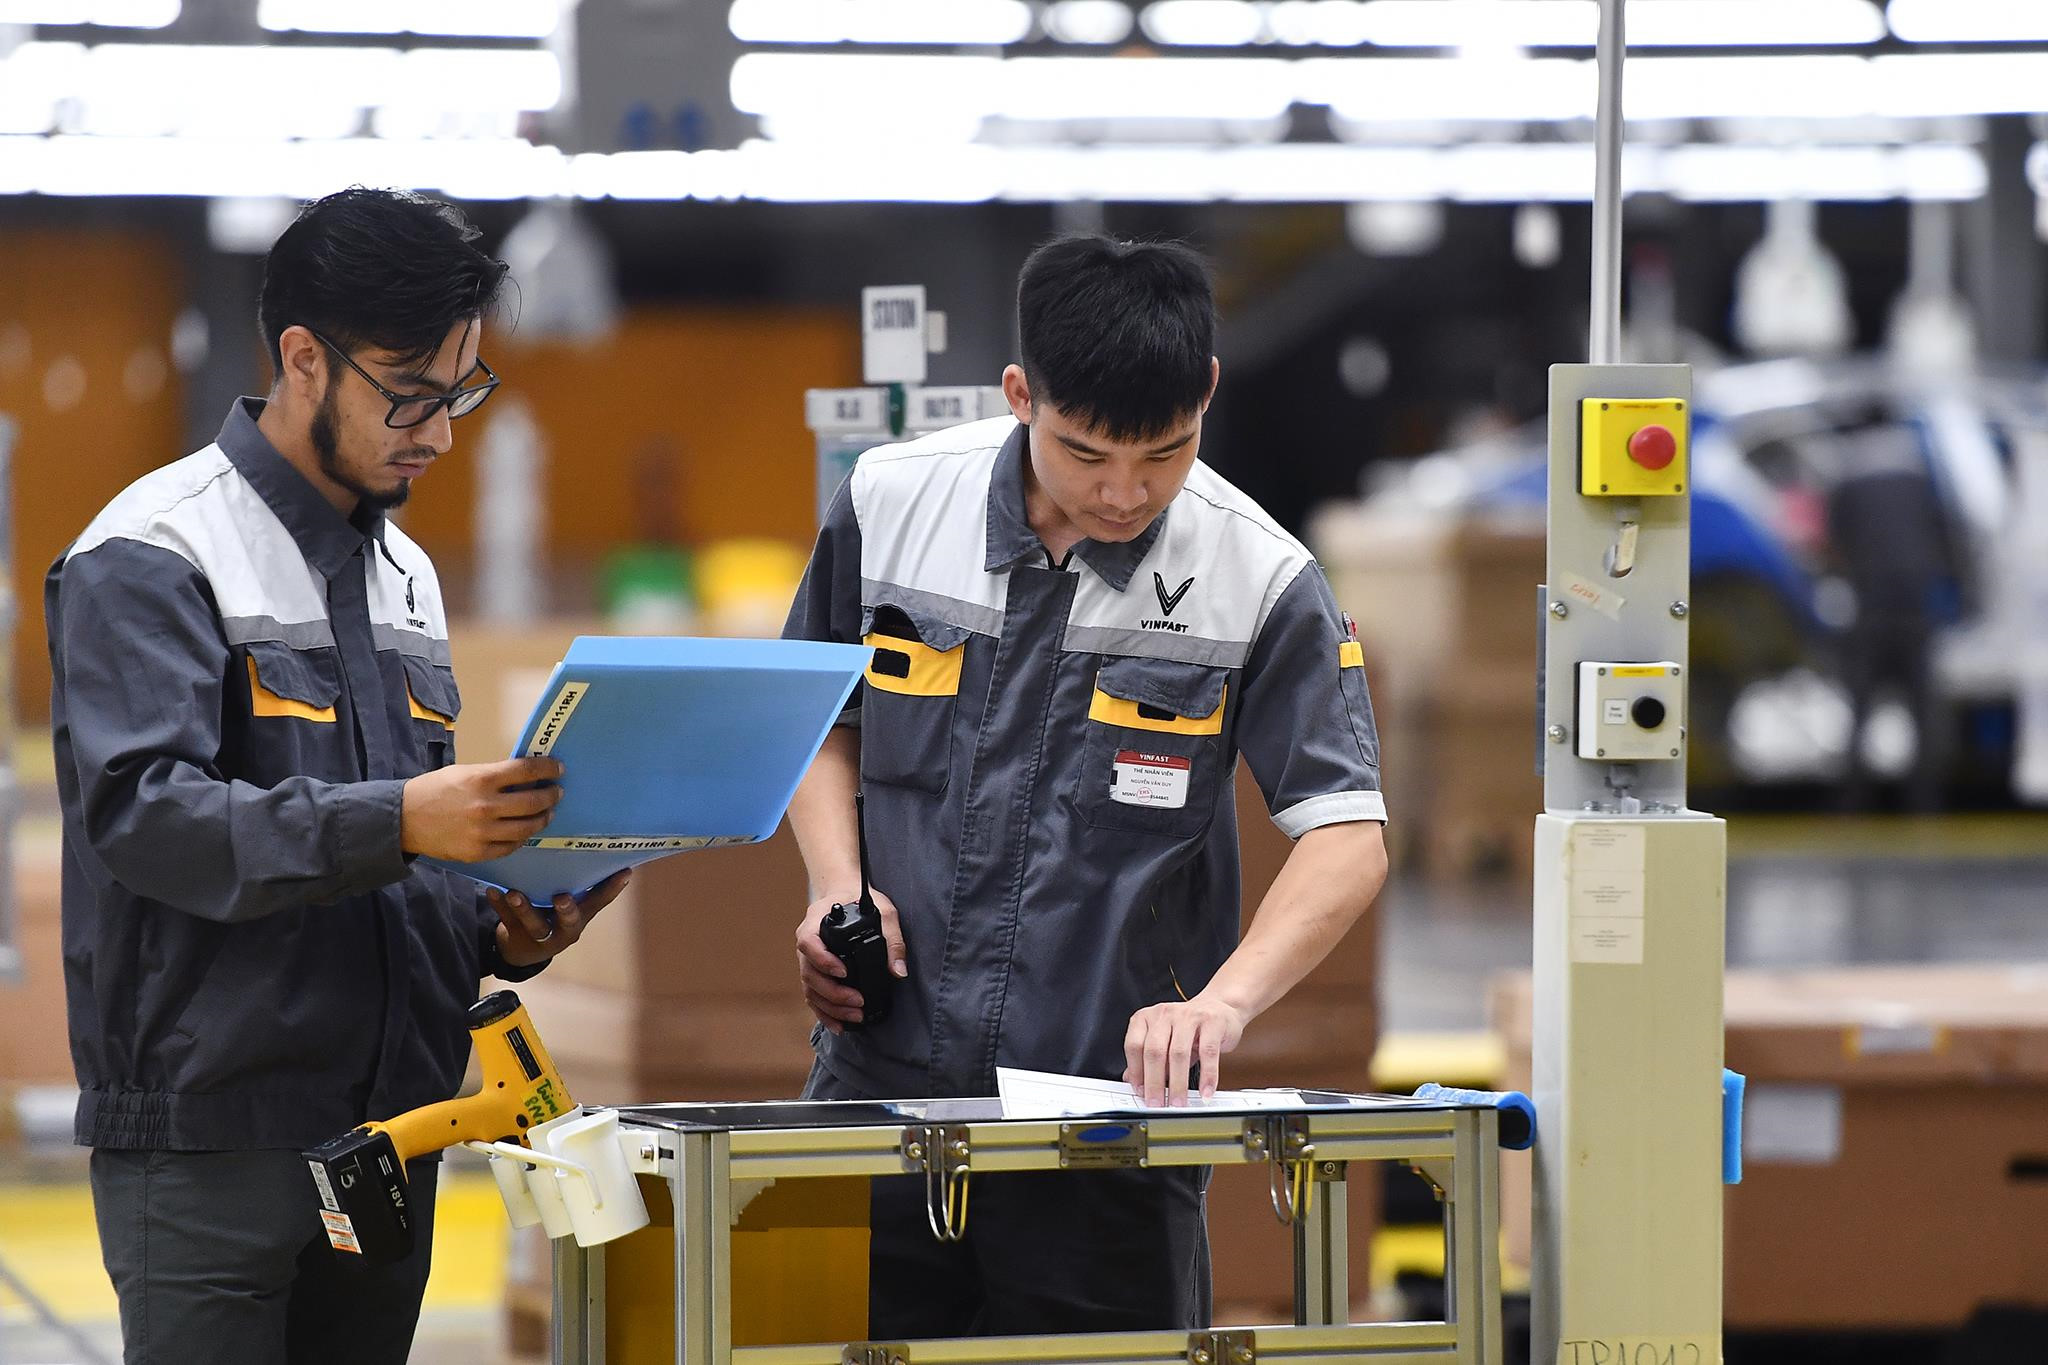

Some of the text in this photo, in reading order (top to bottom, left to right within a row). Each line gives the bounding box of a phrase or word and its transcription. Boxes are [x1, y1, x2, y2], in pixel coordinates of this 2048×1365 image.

[1140, 619, 1189, 633] VINFAST
[1139, 753, 1170, 763] VINFAST
[389, 1184, 405, 1208] 18V
